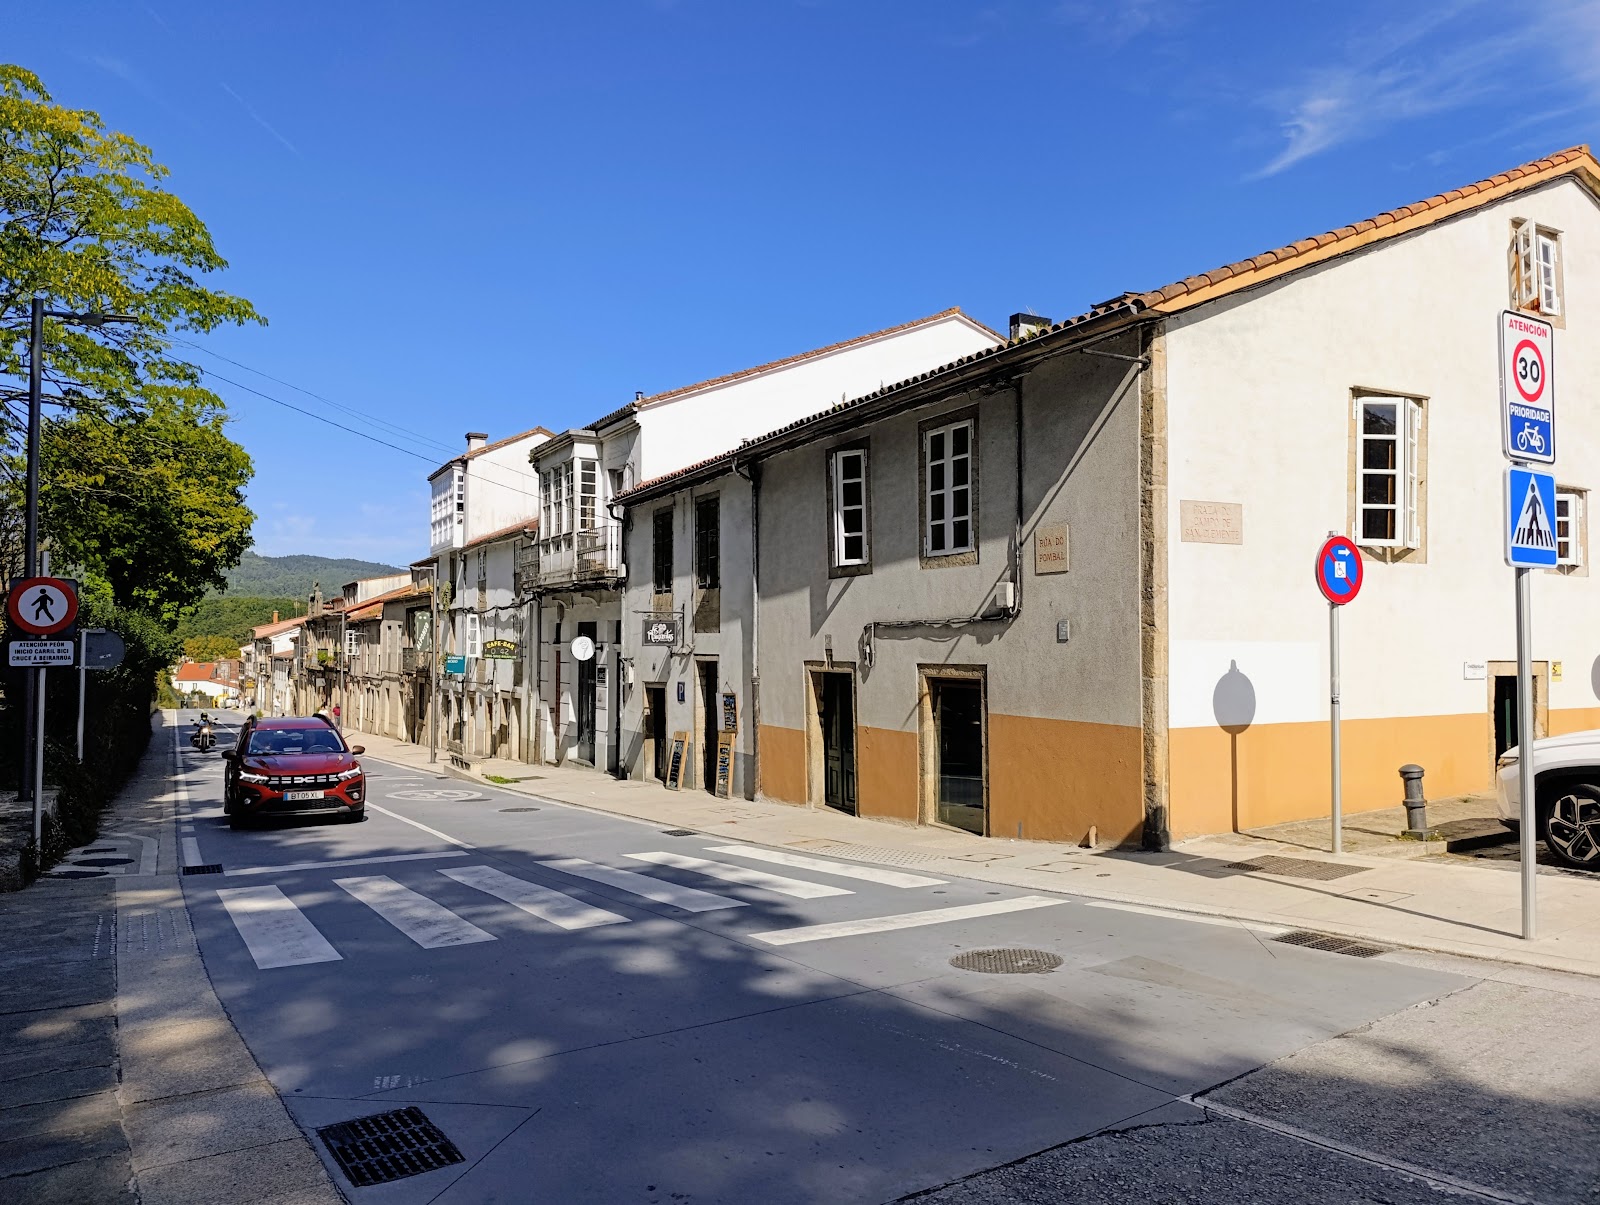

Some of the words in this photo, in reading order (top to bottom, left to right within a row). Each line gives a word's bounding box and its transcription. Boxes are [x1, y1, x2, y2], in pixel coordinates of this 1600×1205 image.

[1508, 318, 1548, 338] ATENCIÓN
[1518, 356, 1540, 383] 30
[1509, 404, 1550, 423] PRIORIDADE
[1193, 504, 1218, 515] PRAZA
[1039, 536, 1052, 548] RÚA
[1055, 536, 1065, 546] DO
[1038, 551, 1065, 563] POMBAL
